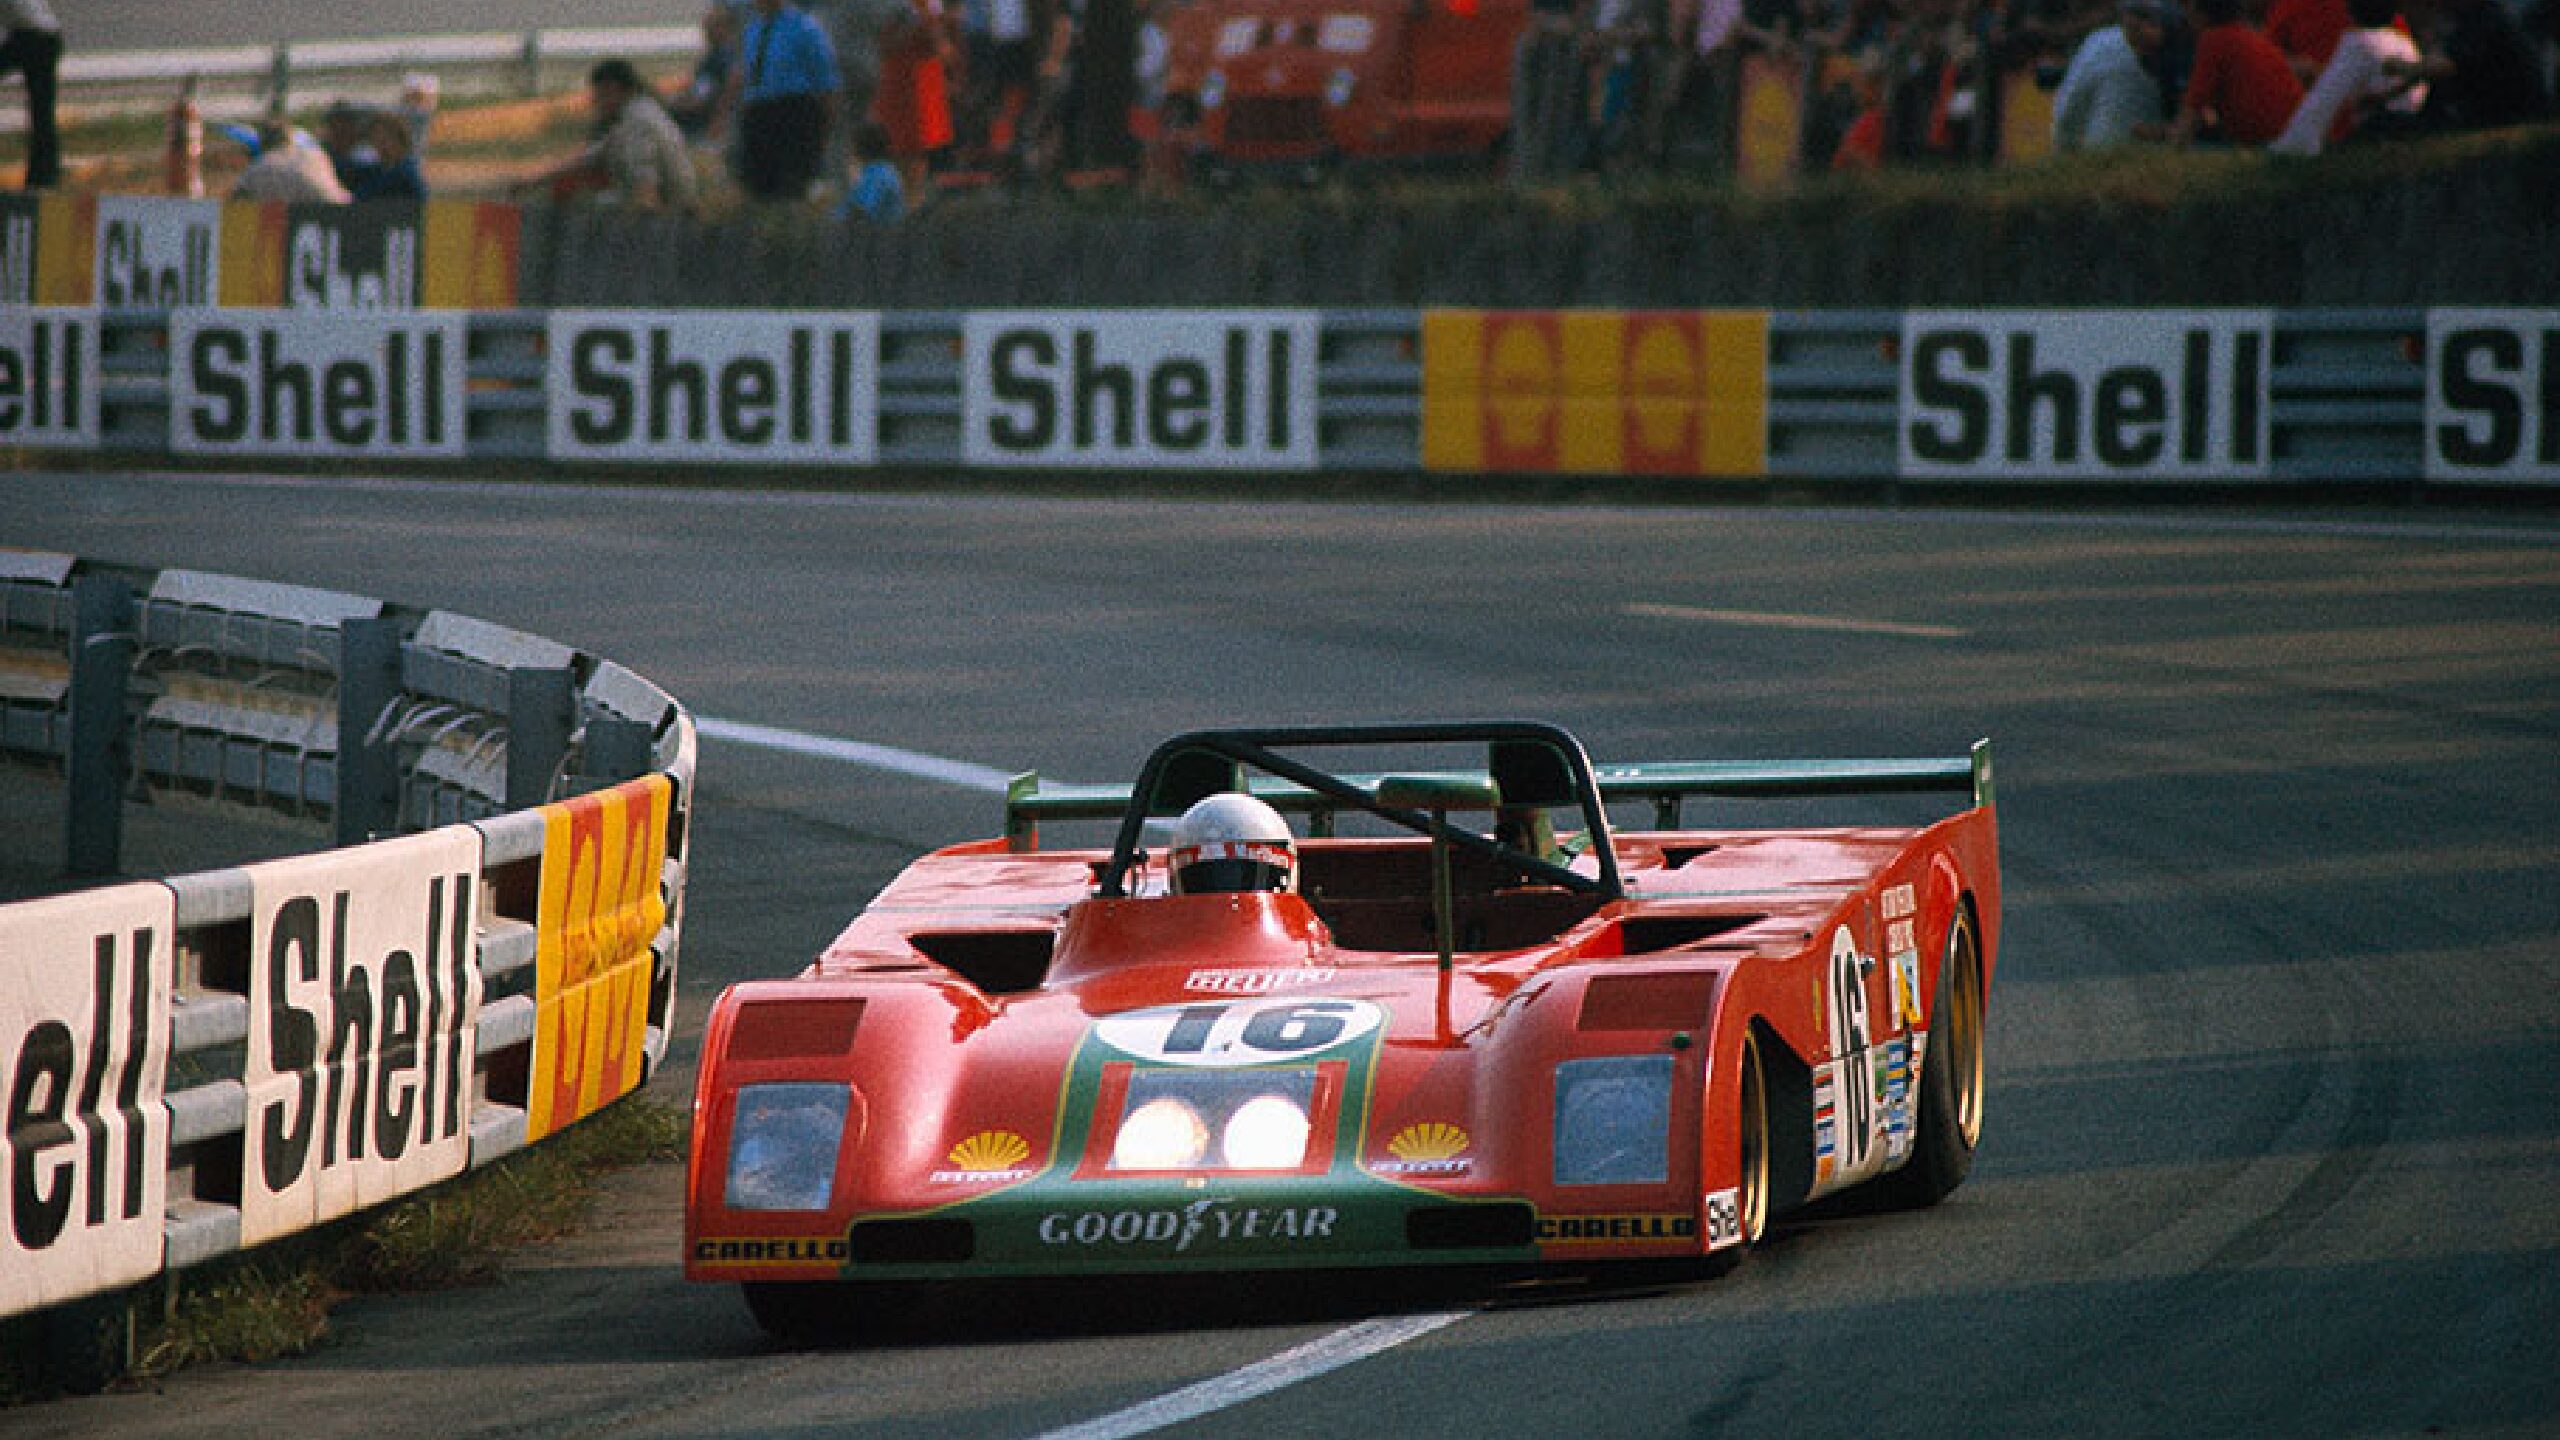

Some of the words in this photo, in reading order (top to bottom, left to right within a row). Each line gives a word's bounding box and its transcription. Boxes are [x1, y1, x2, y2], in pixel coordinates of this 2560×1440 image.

[191, 327, 445, 447] Shell
[570, 326, 852, 447] Shell
[988, 327, 1290, 451] Shell
[1910, 329, 2261, 467] Shell
[2437, 328, 2560, 467] S
[8, 927, 153, 1249] ell
[260, 872, 472, 1193] Shell
[1163, 1002, 1354, 1054] 16
[1834, 951, 1868, 1167] 16
[1534, 1217, 1695, 1238] CARELLO
